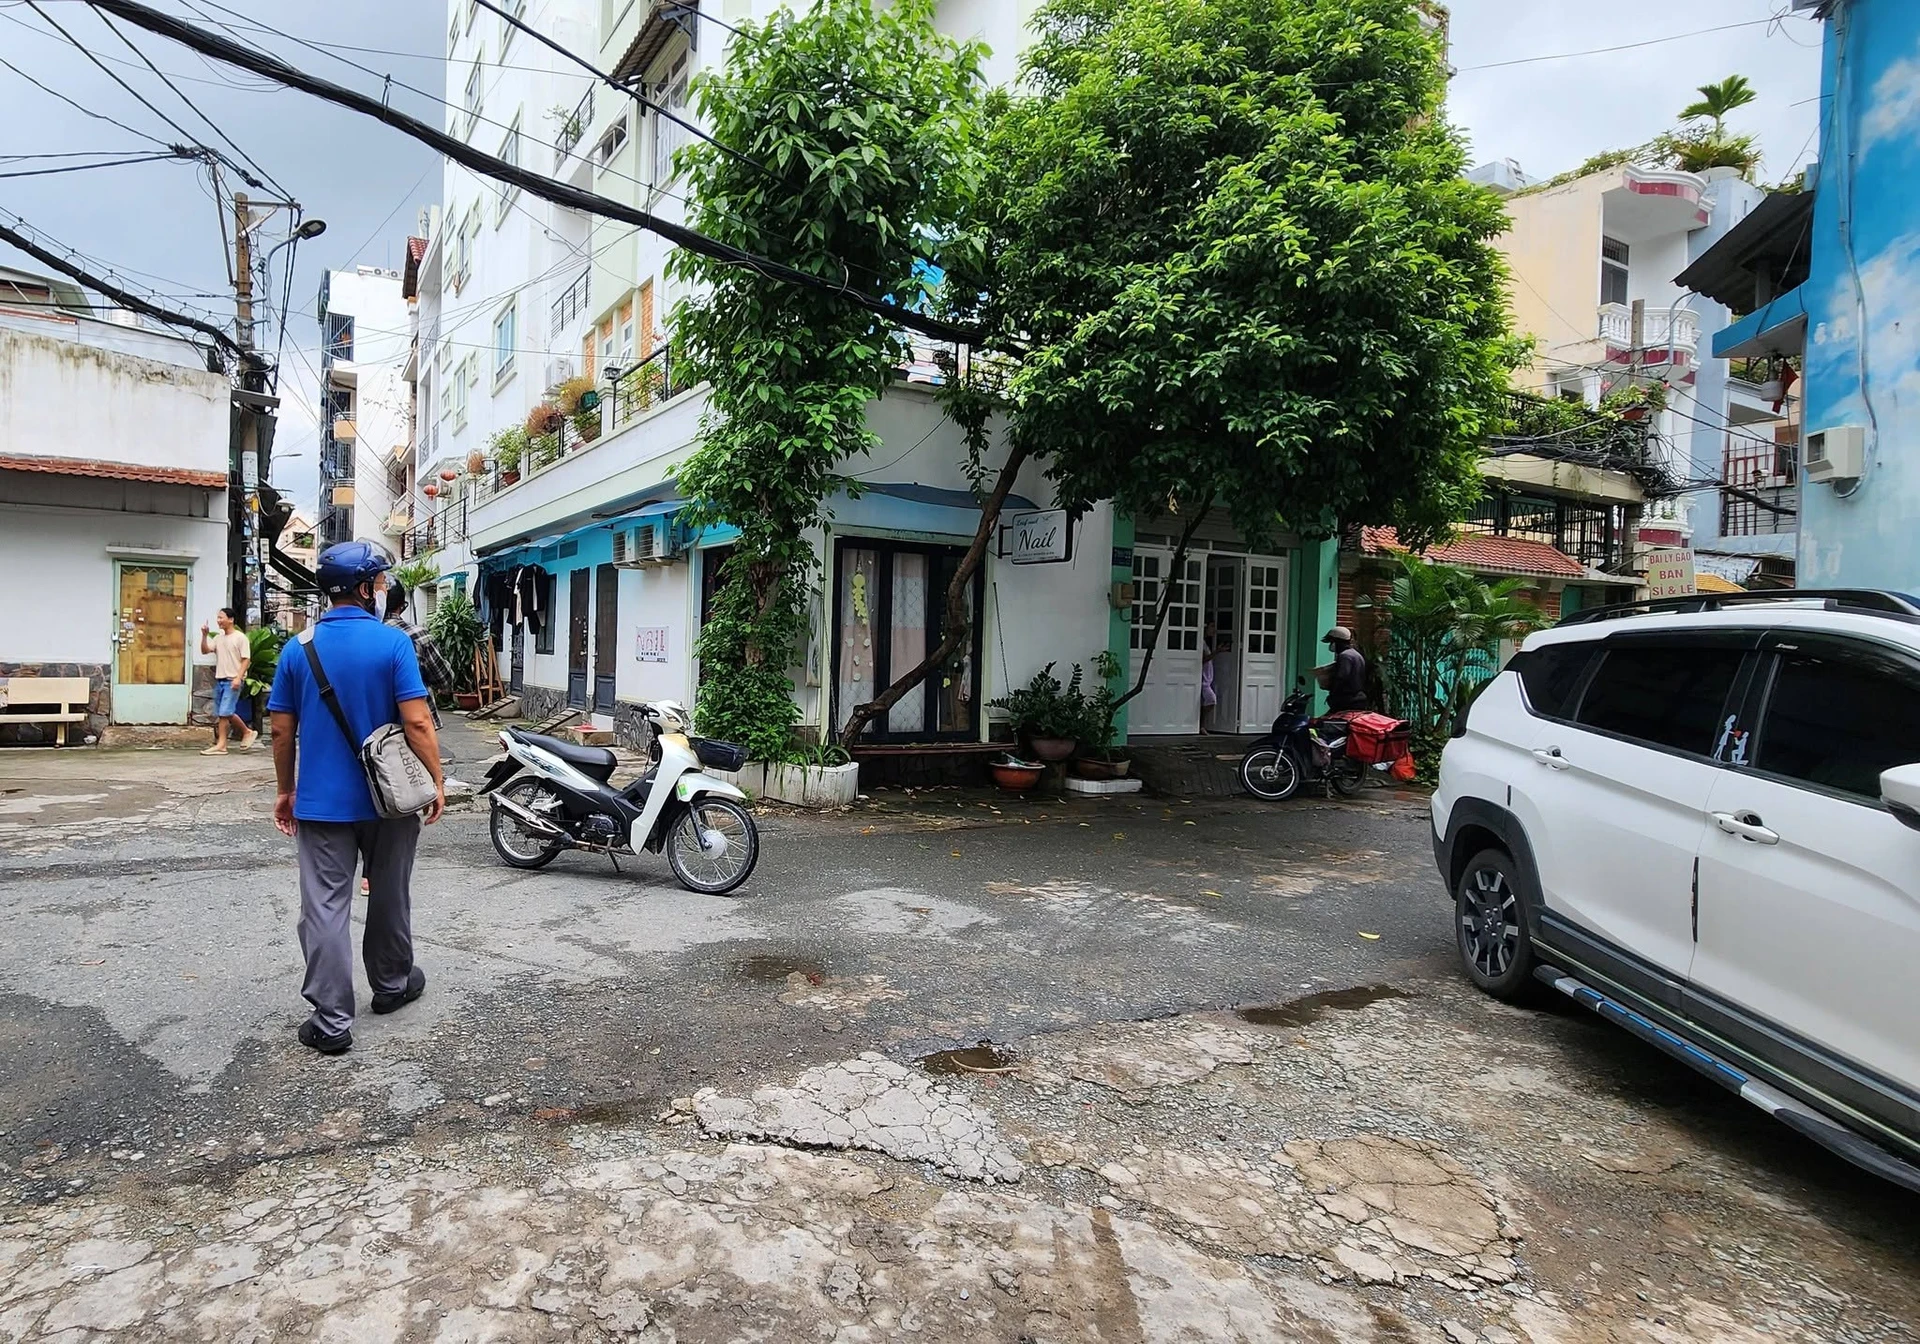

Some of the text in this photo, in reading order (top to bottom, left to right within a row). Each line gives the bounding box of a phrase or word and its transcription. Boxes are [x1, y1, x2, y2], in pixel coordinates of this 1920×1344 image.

[1018, 526, 1057, 551] Nail
[1668, 586, 1676, 595] &
[396, 740, 418, 784] NORTH
